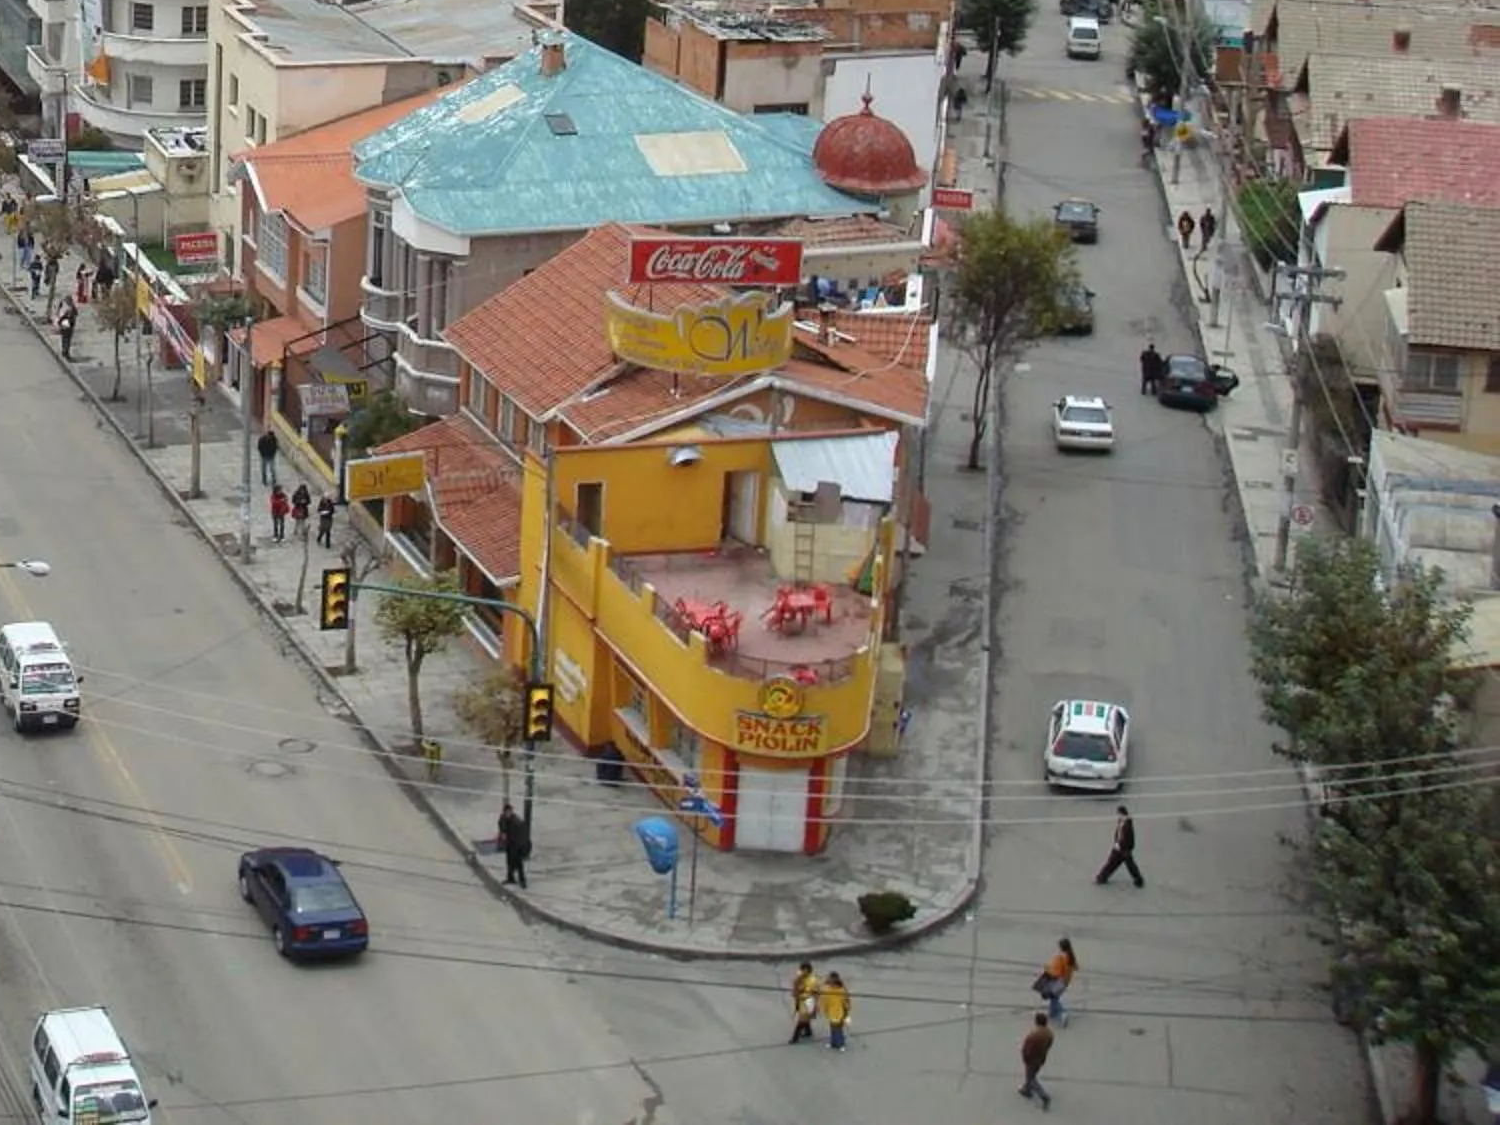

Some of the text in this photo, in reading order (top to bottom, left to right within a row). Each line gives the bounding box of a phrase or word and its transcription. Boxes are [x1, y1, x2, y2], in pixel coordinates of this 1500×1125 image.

[645, 244, 748, 280] Coca-Cola
[738, 715, 821, 736] SNACK
[738, 732, 819, 752] PIOLIN
